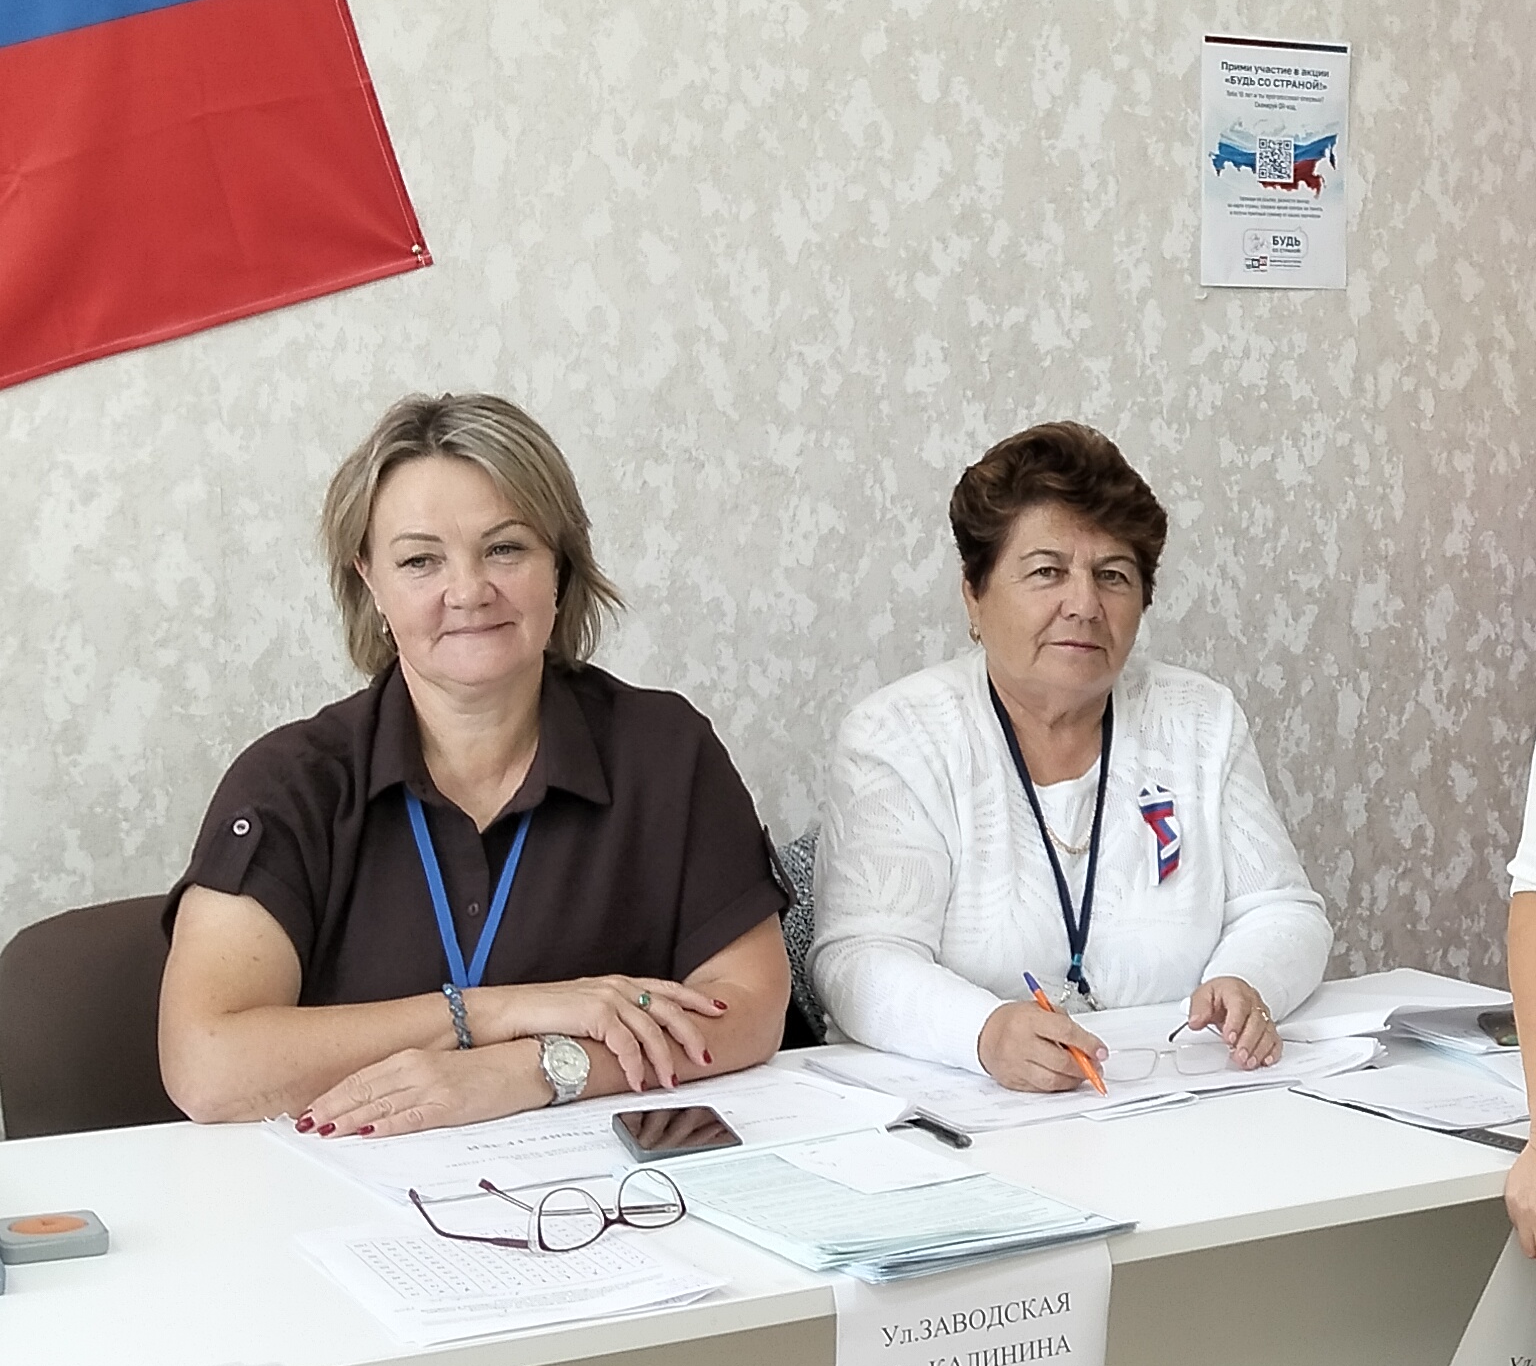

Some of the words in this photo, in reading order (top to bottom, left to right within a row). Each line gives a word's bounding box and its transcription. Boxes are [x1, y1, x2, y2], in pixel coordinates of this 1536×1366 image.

[1221, 61, 1252, 72] Прими
[1254, 66, 1292, 75] участие
[1301, 69, 1329, 77] акции
[1257, 78, 1271, 87] СО
[1272, 235, 1301, 247] БУДЬ
[881, 1291, 1071, 1348] Ул.ЗАВОДСКАЯ
